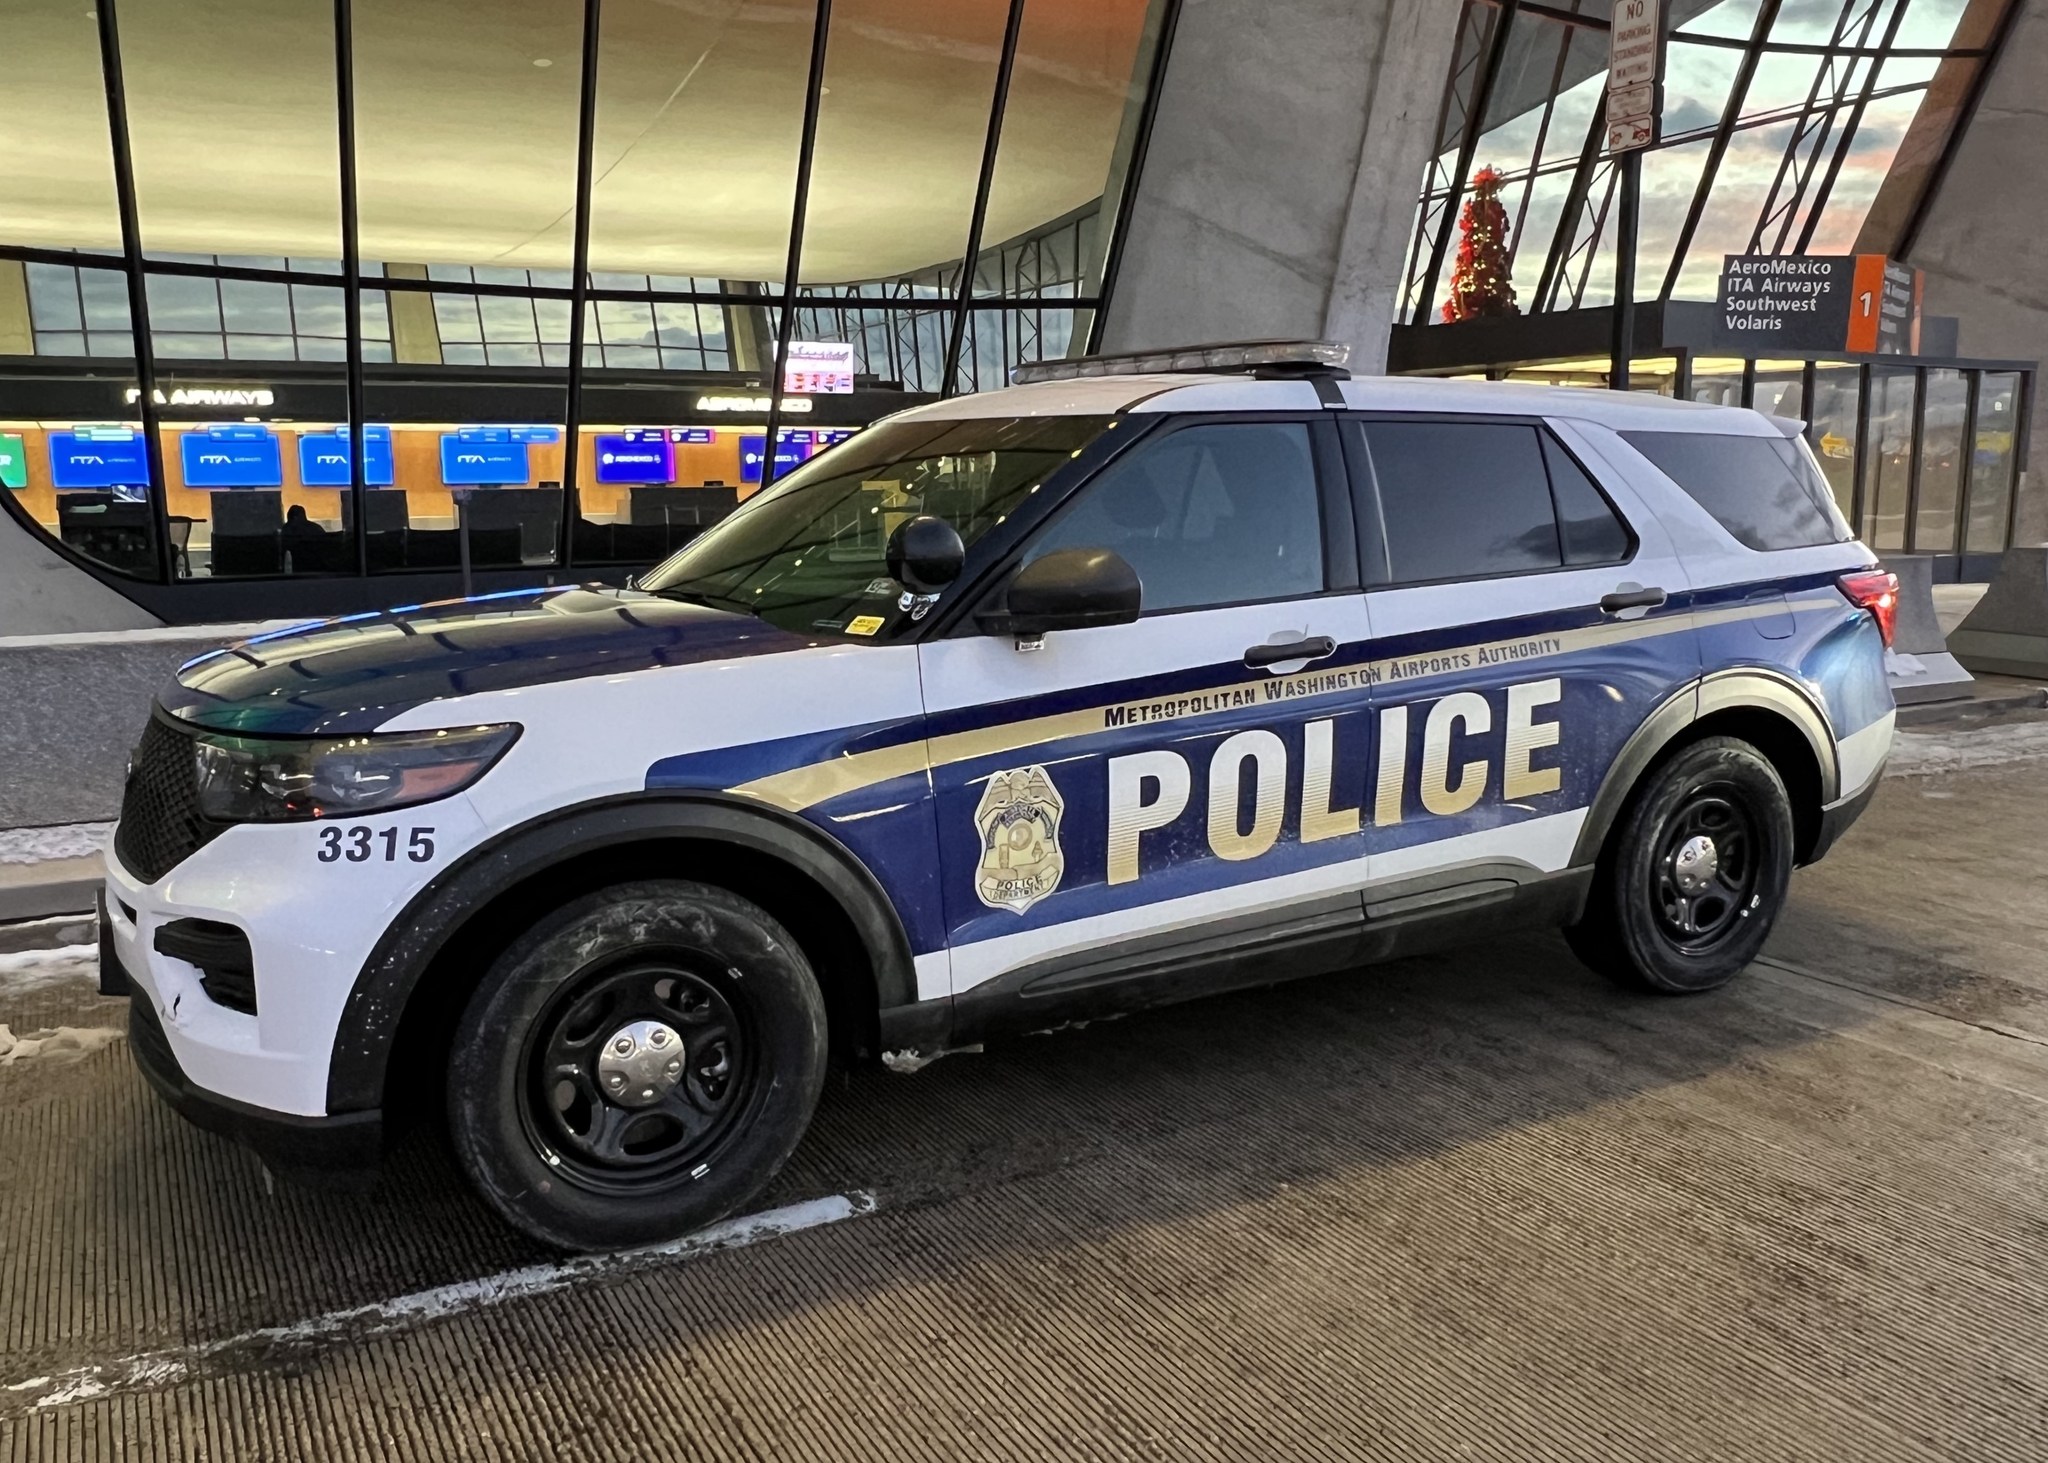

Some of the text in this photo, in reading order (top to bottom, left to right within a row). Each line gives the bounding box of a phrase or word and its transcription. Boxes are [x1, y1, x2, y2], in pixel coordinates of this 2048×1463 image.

[1626, 1, 1644, 20] NO
[1617, 24, 1651, 42] PARKING
[1729, 259, 1831, 275] AeroMexico
[1727, 277, 1831, 297] ITA Airways
[1726, 296, 1817, 312] Southwest
[1859, 291, 1872, 317] 1
[1726, 314, 1782, 330] Volaris
[170, 389, 275, 406] AIRWAYS
[1104, 638, 1562, 728] METROPOLITAN WASHINGTON AIRPORTS AUTHORITY
[1107, 678, 1561, 885] POLICE
[317, 826, 435, 862] 3315
[996, 875, 1042, 891] POLICE
